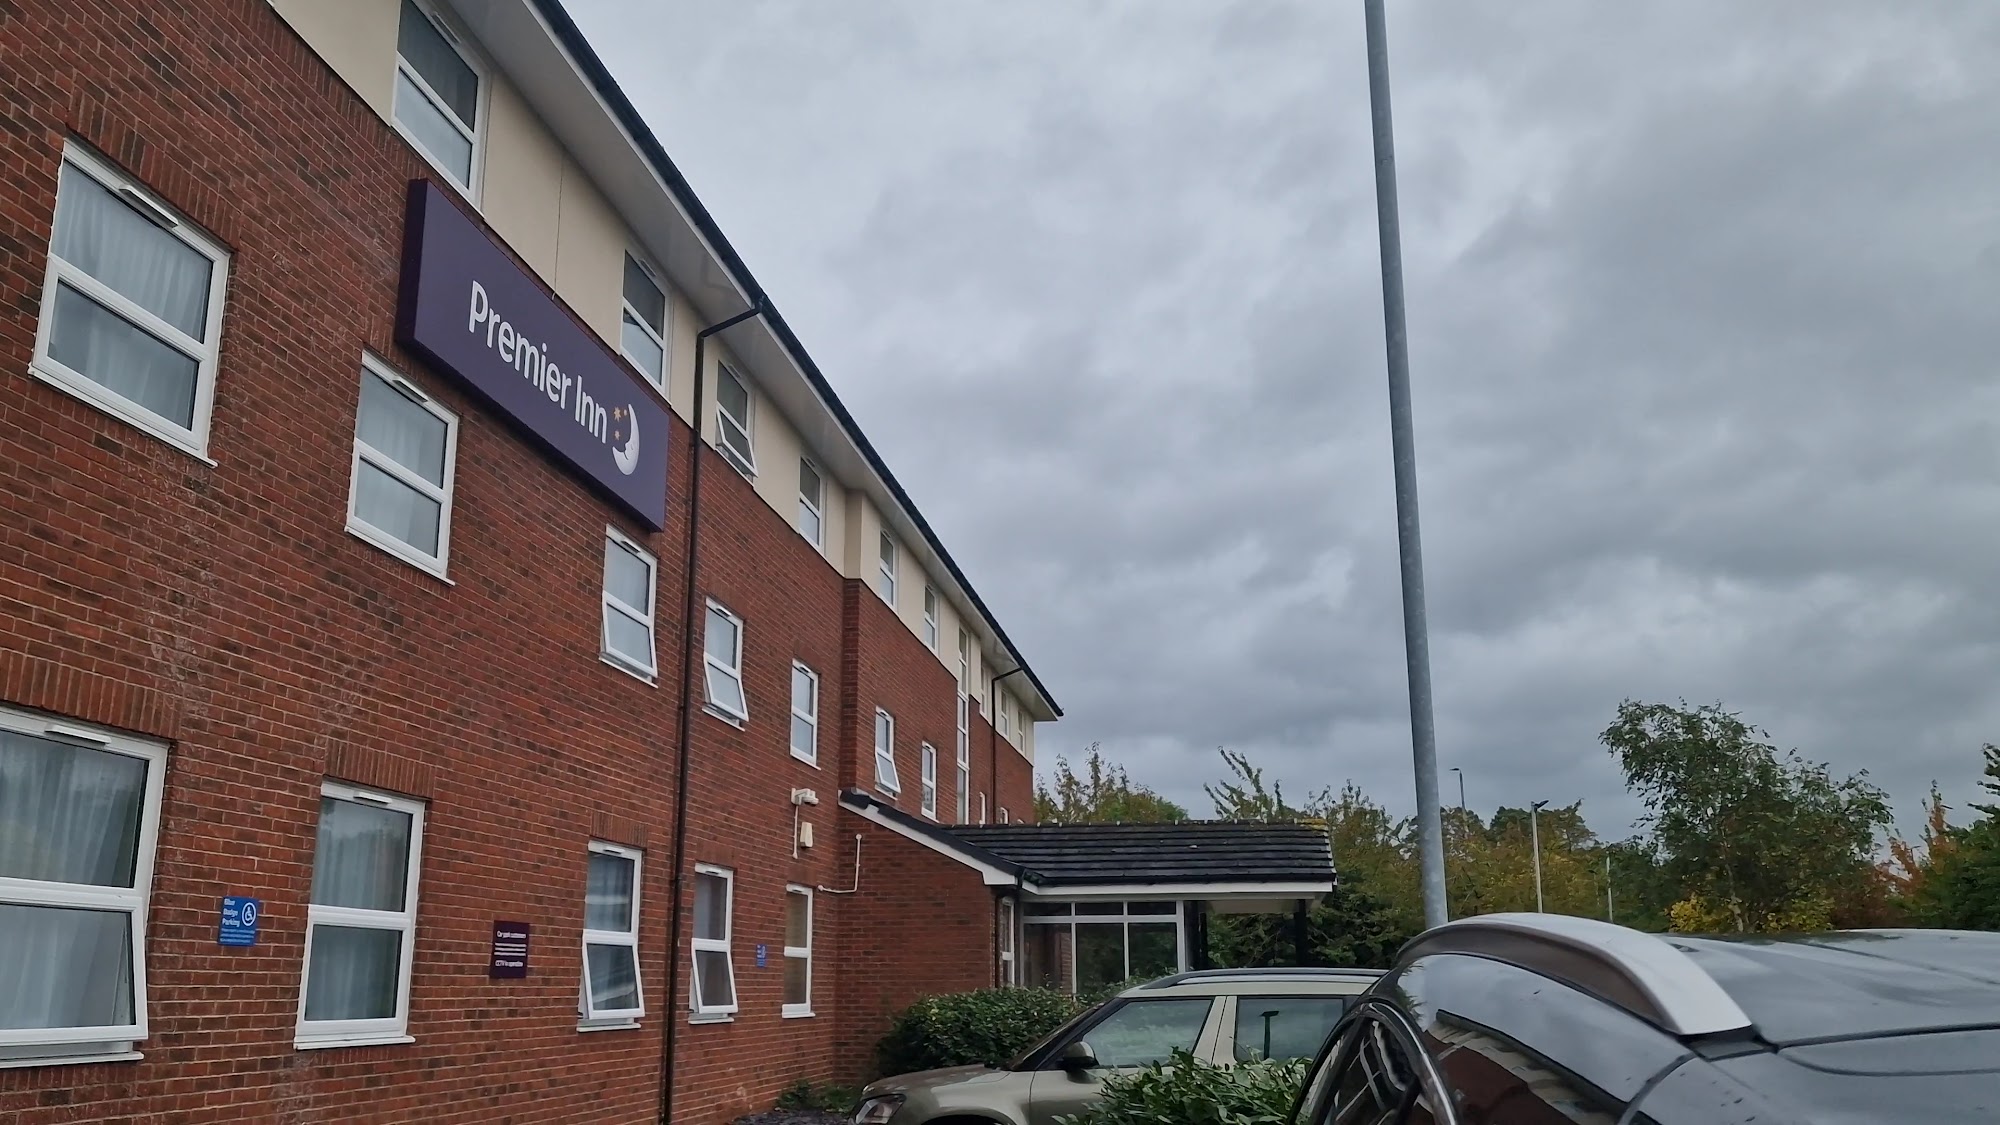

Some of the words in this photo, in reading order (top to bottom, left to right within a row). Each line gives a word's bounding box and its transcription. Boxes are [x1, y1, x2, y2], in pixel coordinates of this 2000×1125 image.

[468, 280, 572, 410] Premier
[575, 375, 608, 444] Inn
[222, 918, 241, 928] Parking
